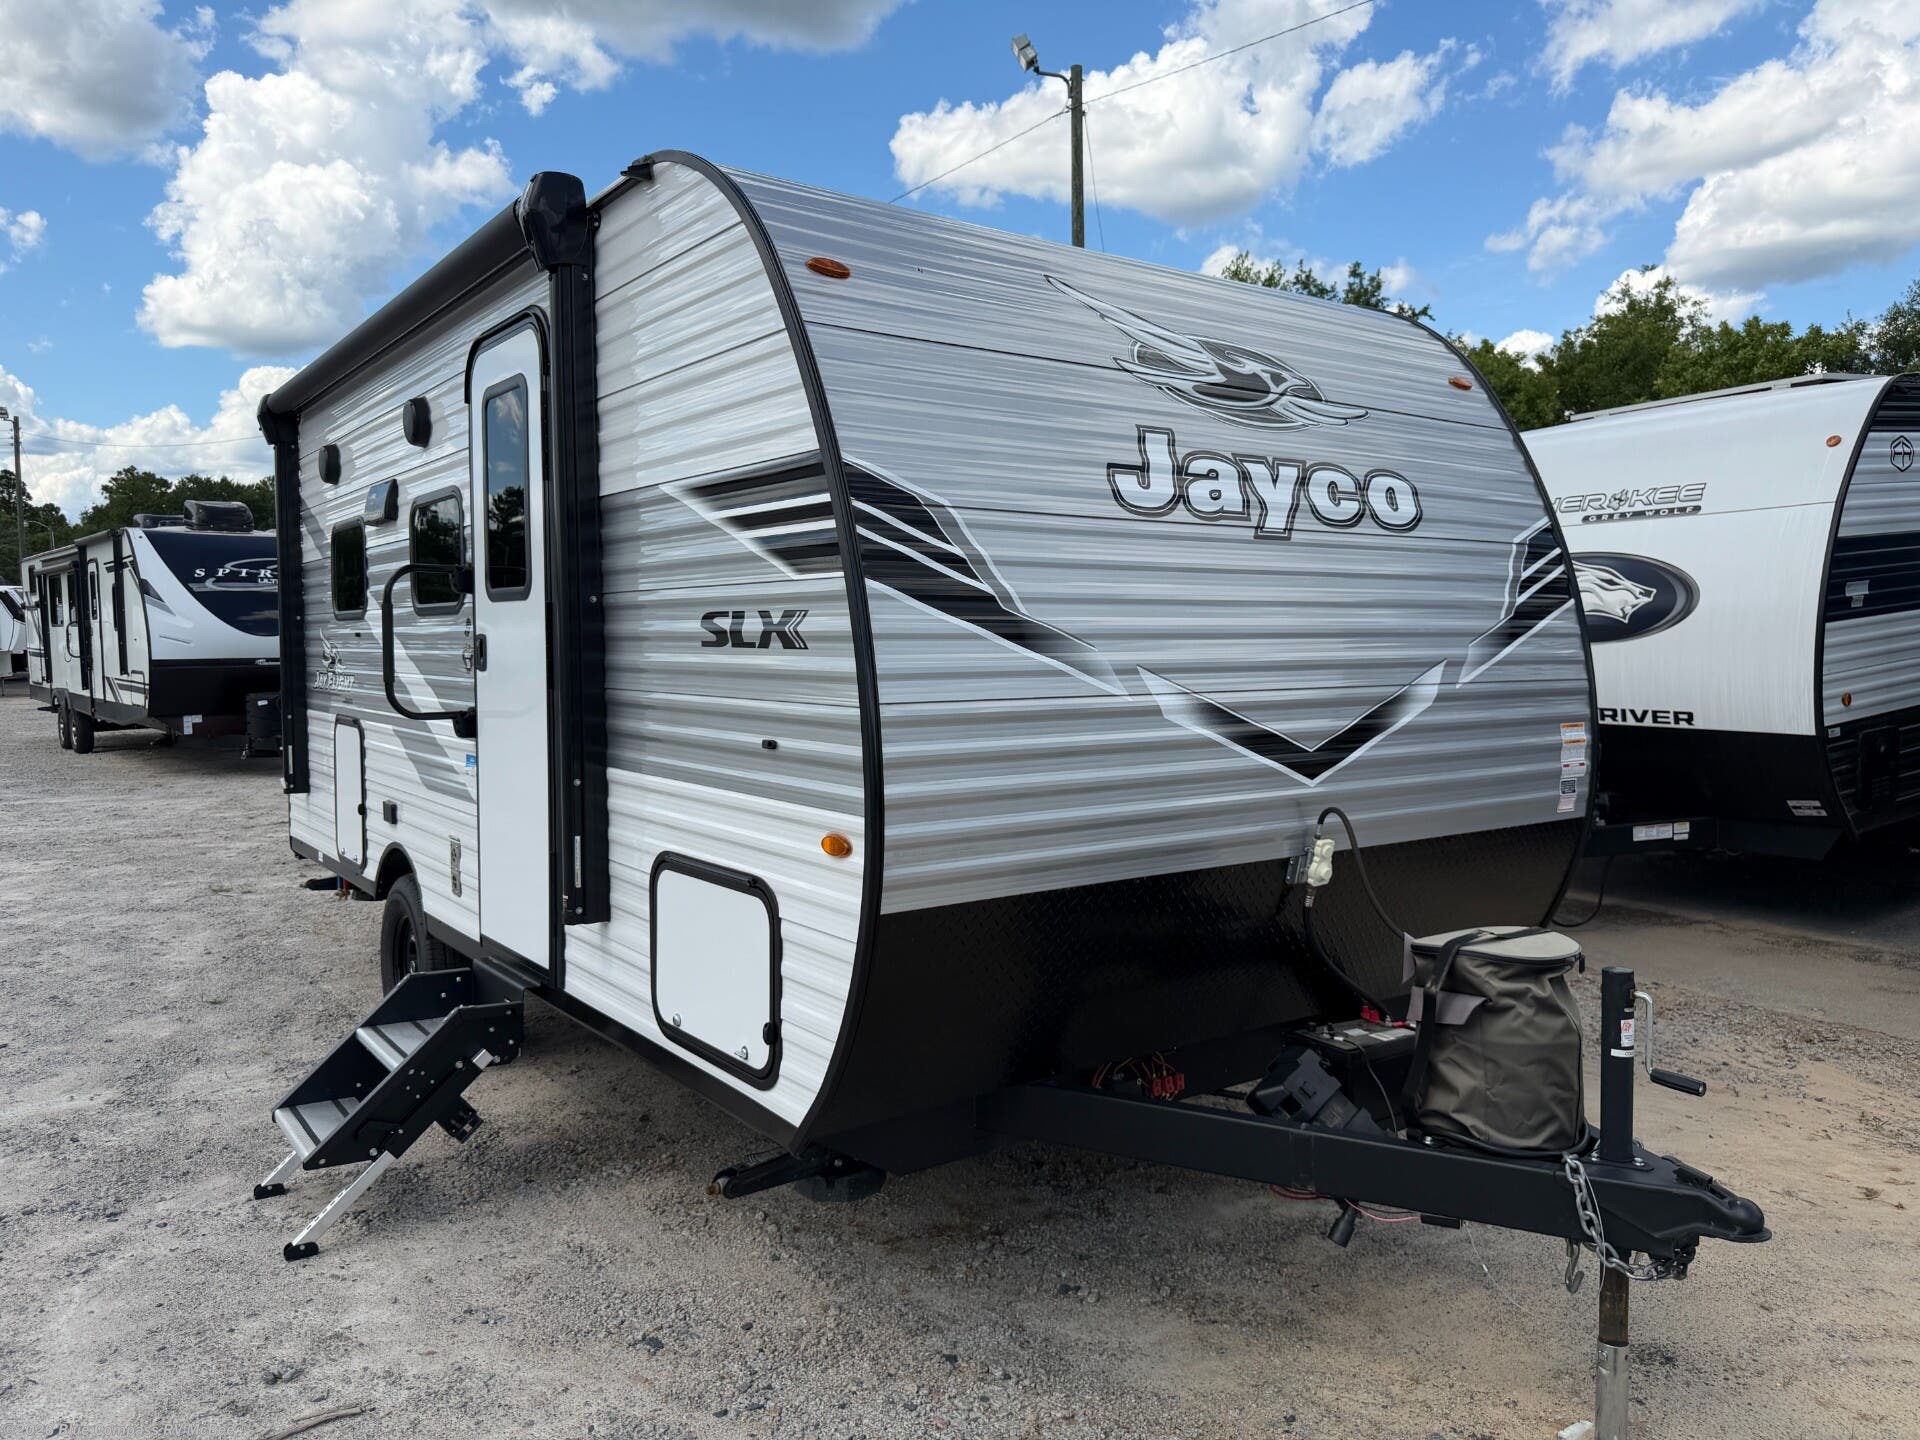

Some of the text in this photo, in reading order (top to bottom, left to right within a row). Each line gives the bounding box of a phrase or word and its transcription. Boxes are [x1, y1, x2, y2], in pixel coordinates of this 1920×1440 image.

[1106, 424, 1423, 541] Jayco
[1588, 506, 1695, 522] GREY WOLF
[700, 609, 809, 650] SLX
[312, 670, 328, 690] JAY
[1598, 707, 1695, 726] RIVER
